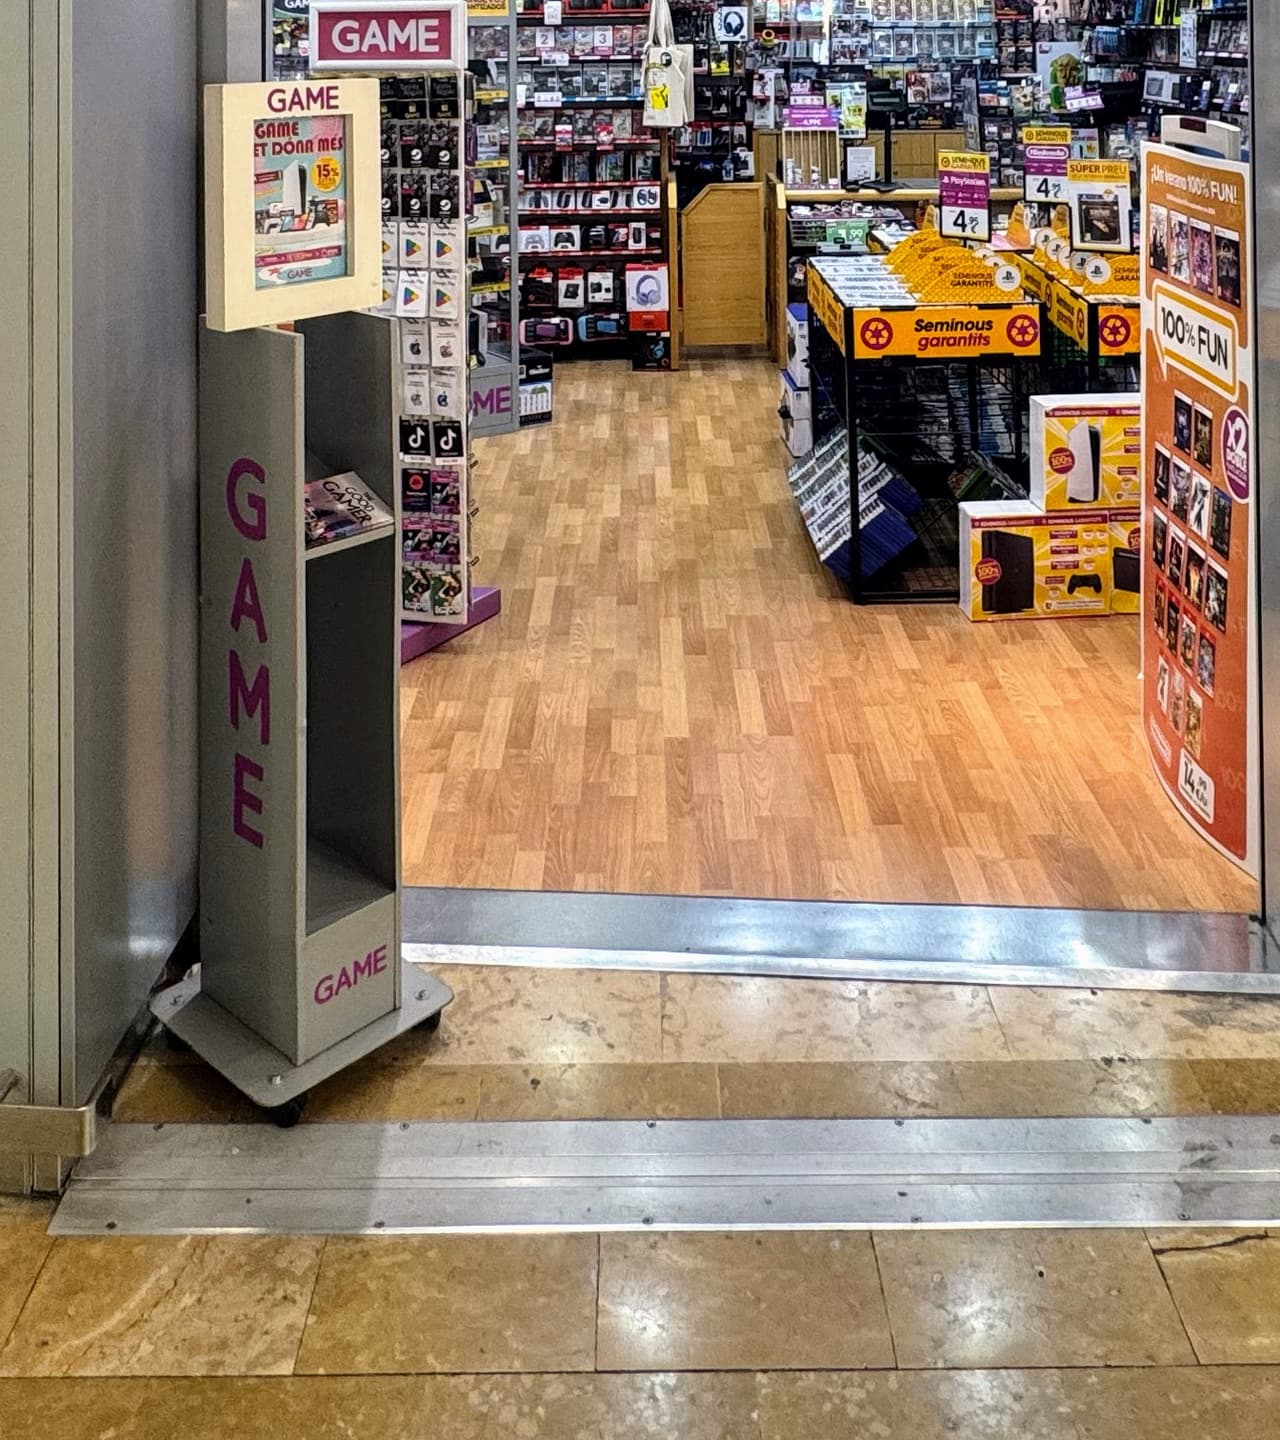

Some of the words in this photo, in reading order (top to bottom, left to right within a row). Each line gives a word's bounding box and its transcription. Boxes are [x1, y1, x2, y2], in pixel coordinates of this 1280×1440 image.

[331, 18, 440, 54] GAME
[540, 33, 550, 45] 2
[598, 33, 607, 45] 3
[267, 86, 340, 113] GAME
[254, 121, 300, 140] GAME
[317, 134, 344, 153] MÉS
[316, 163, 340, 180] 15%
[1069, 160, 1100, 174] SÚPER
[1101, 161, 1127, 174] PREU
[949, 176, 987, 187] PlayStation
[1187, 171, 1210, 198] 100%
[1210, 180, 1238, 205] FUN!
[287, 268, 313, 280] GAME
[914, 318, 994, 333] Seminous
[917, 332, 991, 351] garantits
[1160, 306, 1196, 348] 100%
[1197, 324, 1228, 370] FUN
[471, 385, 513, 417] ME
[1226, 416, 1248, 459] X2
[322, 480, 373, 526] GAMER
[345, 486, 376, 513] GOOD
[225, 456, 271, 849] GAME
[313, 944, 389, 1007] GAME
